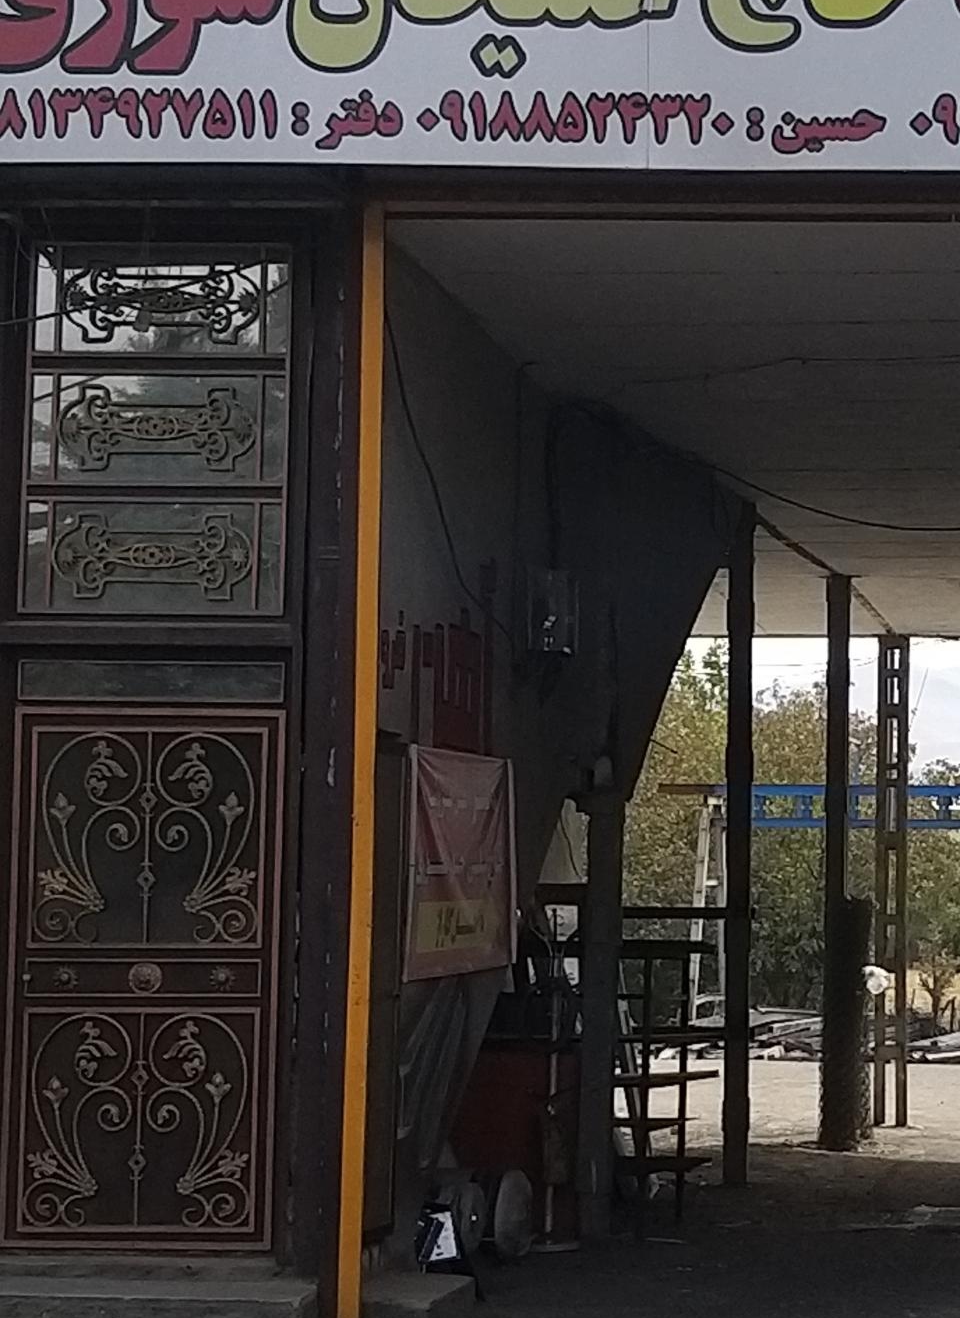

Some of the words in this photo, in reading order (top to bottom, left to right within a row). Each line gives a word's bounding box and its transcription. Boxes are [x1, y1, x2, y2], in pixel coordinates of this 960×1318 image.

[315, 89, 403, 150] دفتر
[417, 90, 734, 145] ۰۹۱۸۸۵۲۴۳۲۰
[771, 109, 887, 154] حسین
